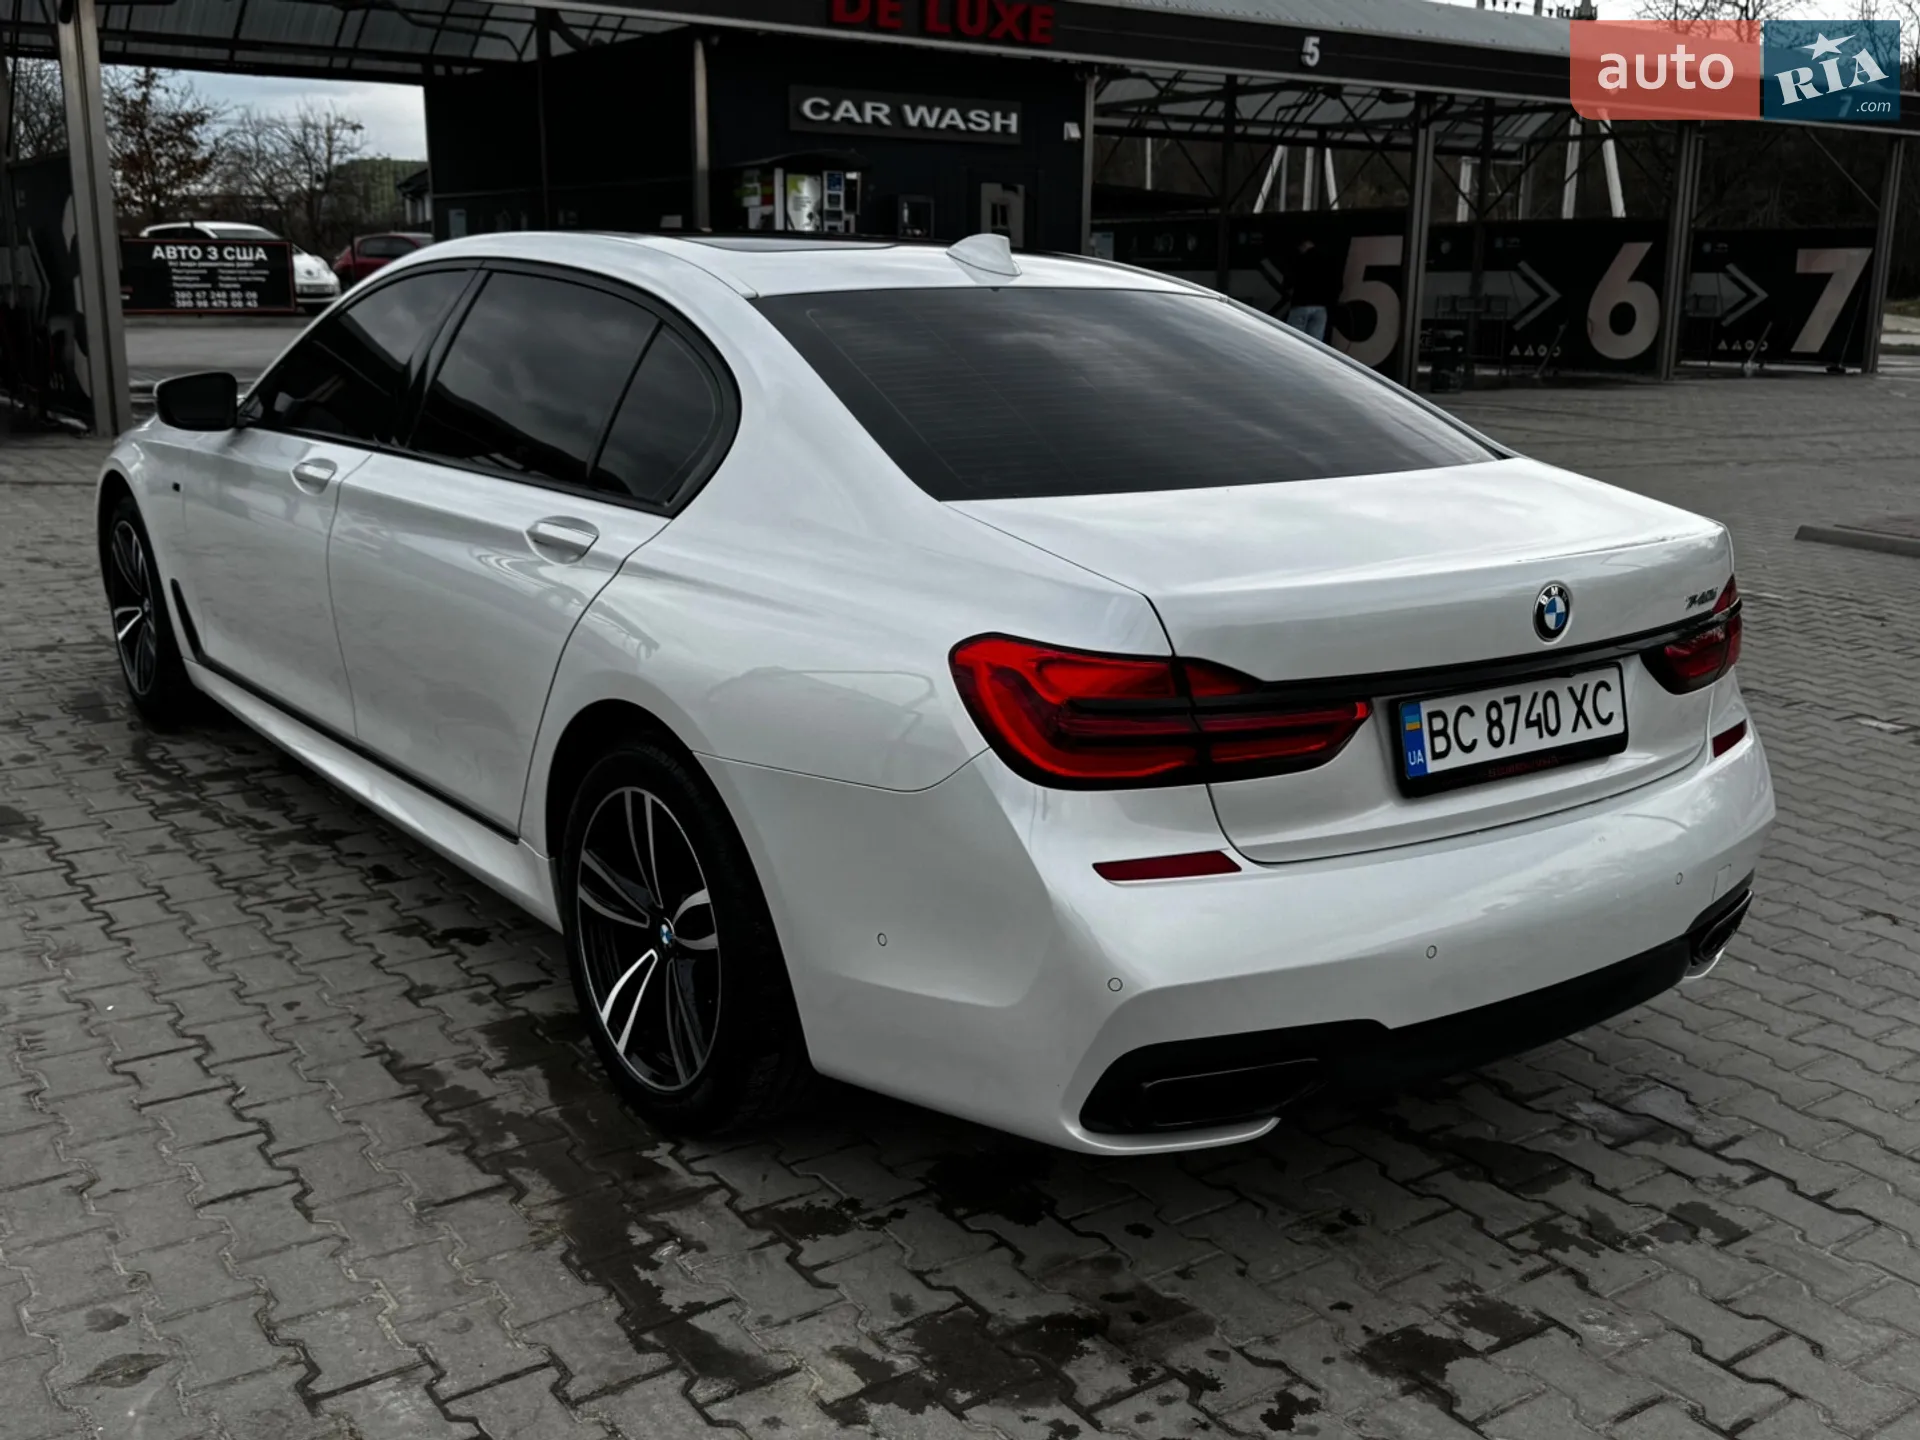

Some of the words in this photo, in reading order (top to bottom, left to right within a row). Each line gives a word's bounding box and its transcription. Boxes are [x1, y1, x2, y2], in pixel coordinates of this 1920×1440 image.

[832, 0, 904, 31] DE
[924, 0, 1055, 44] LUXE
[1301, 36, 1320, 67] 5
[802, 97, 892, 126] CAR
[902, 103, 1018, 134] WASH
[152, 245, 202, 260] АВТО
[223, 246, 268, 261] США
[1331, 235, 1404, 368] 5
[1587, 242, 1660, 359] 6
[1790, 247, 1873, 353] 7
[1426, 704, 1478, 761] BC
[1485, 689, 1562, 749] 8740
[1567, 679, 1615, 734] XC
[1408, 750, 1425, 766] UA
